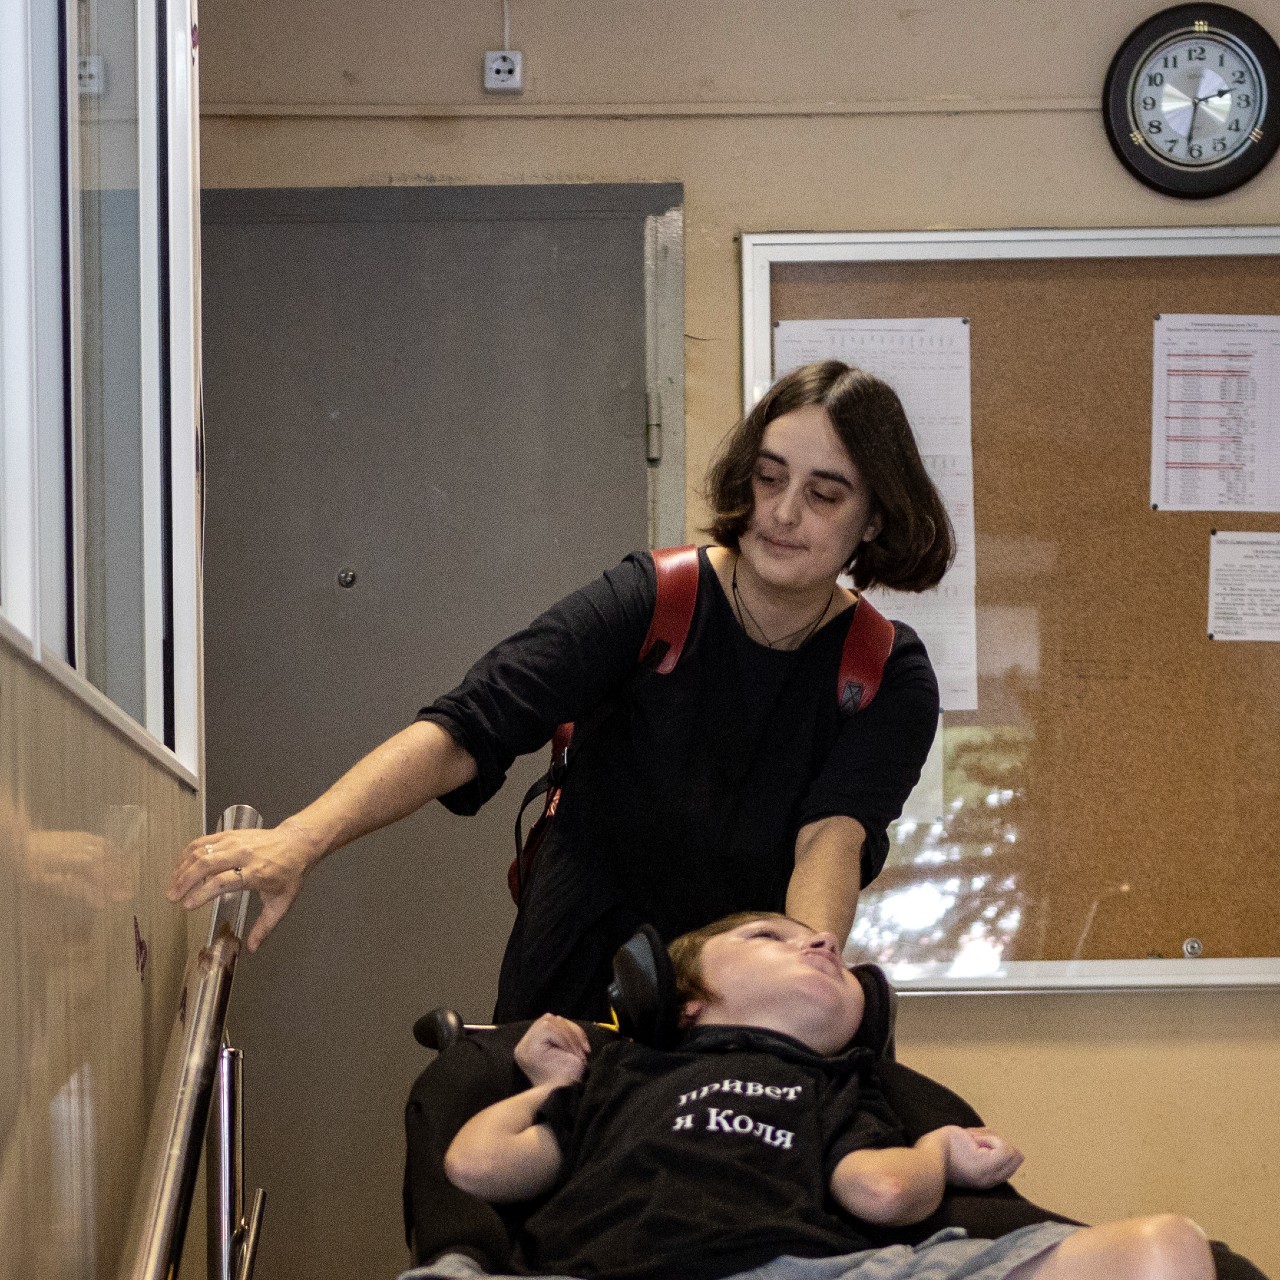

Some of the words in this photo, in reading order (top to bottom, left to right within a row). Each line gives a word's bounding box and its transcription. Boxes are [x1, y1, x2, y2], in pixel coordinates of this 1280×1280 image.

[1187, 46, 1207, 61] 12
[1218, 54, 1225, 67] 1
[1162, 55, 1178, 69] 11
[1147, 72, 1164, 87] 10
[1231, 70, 1246, 85] 2
[1142, 96, 1156, 111] 9
[1236, 94, 1251, 109] 3
[1148, 120, 1162, 134] 8
[1228, 118, 1240, 132] 4
[1164, 139, 1179, 153] 7
[1188, 143, 1203, 159] 6
[1212, 137, 1227, 152] 5
[678, 1079, 803, 1107] привет
[672, 1113, 695, 1132] я
[706, 1107, 796, 1150] Коля
